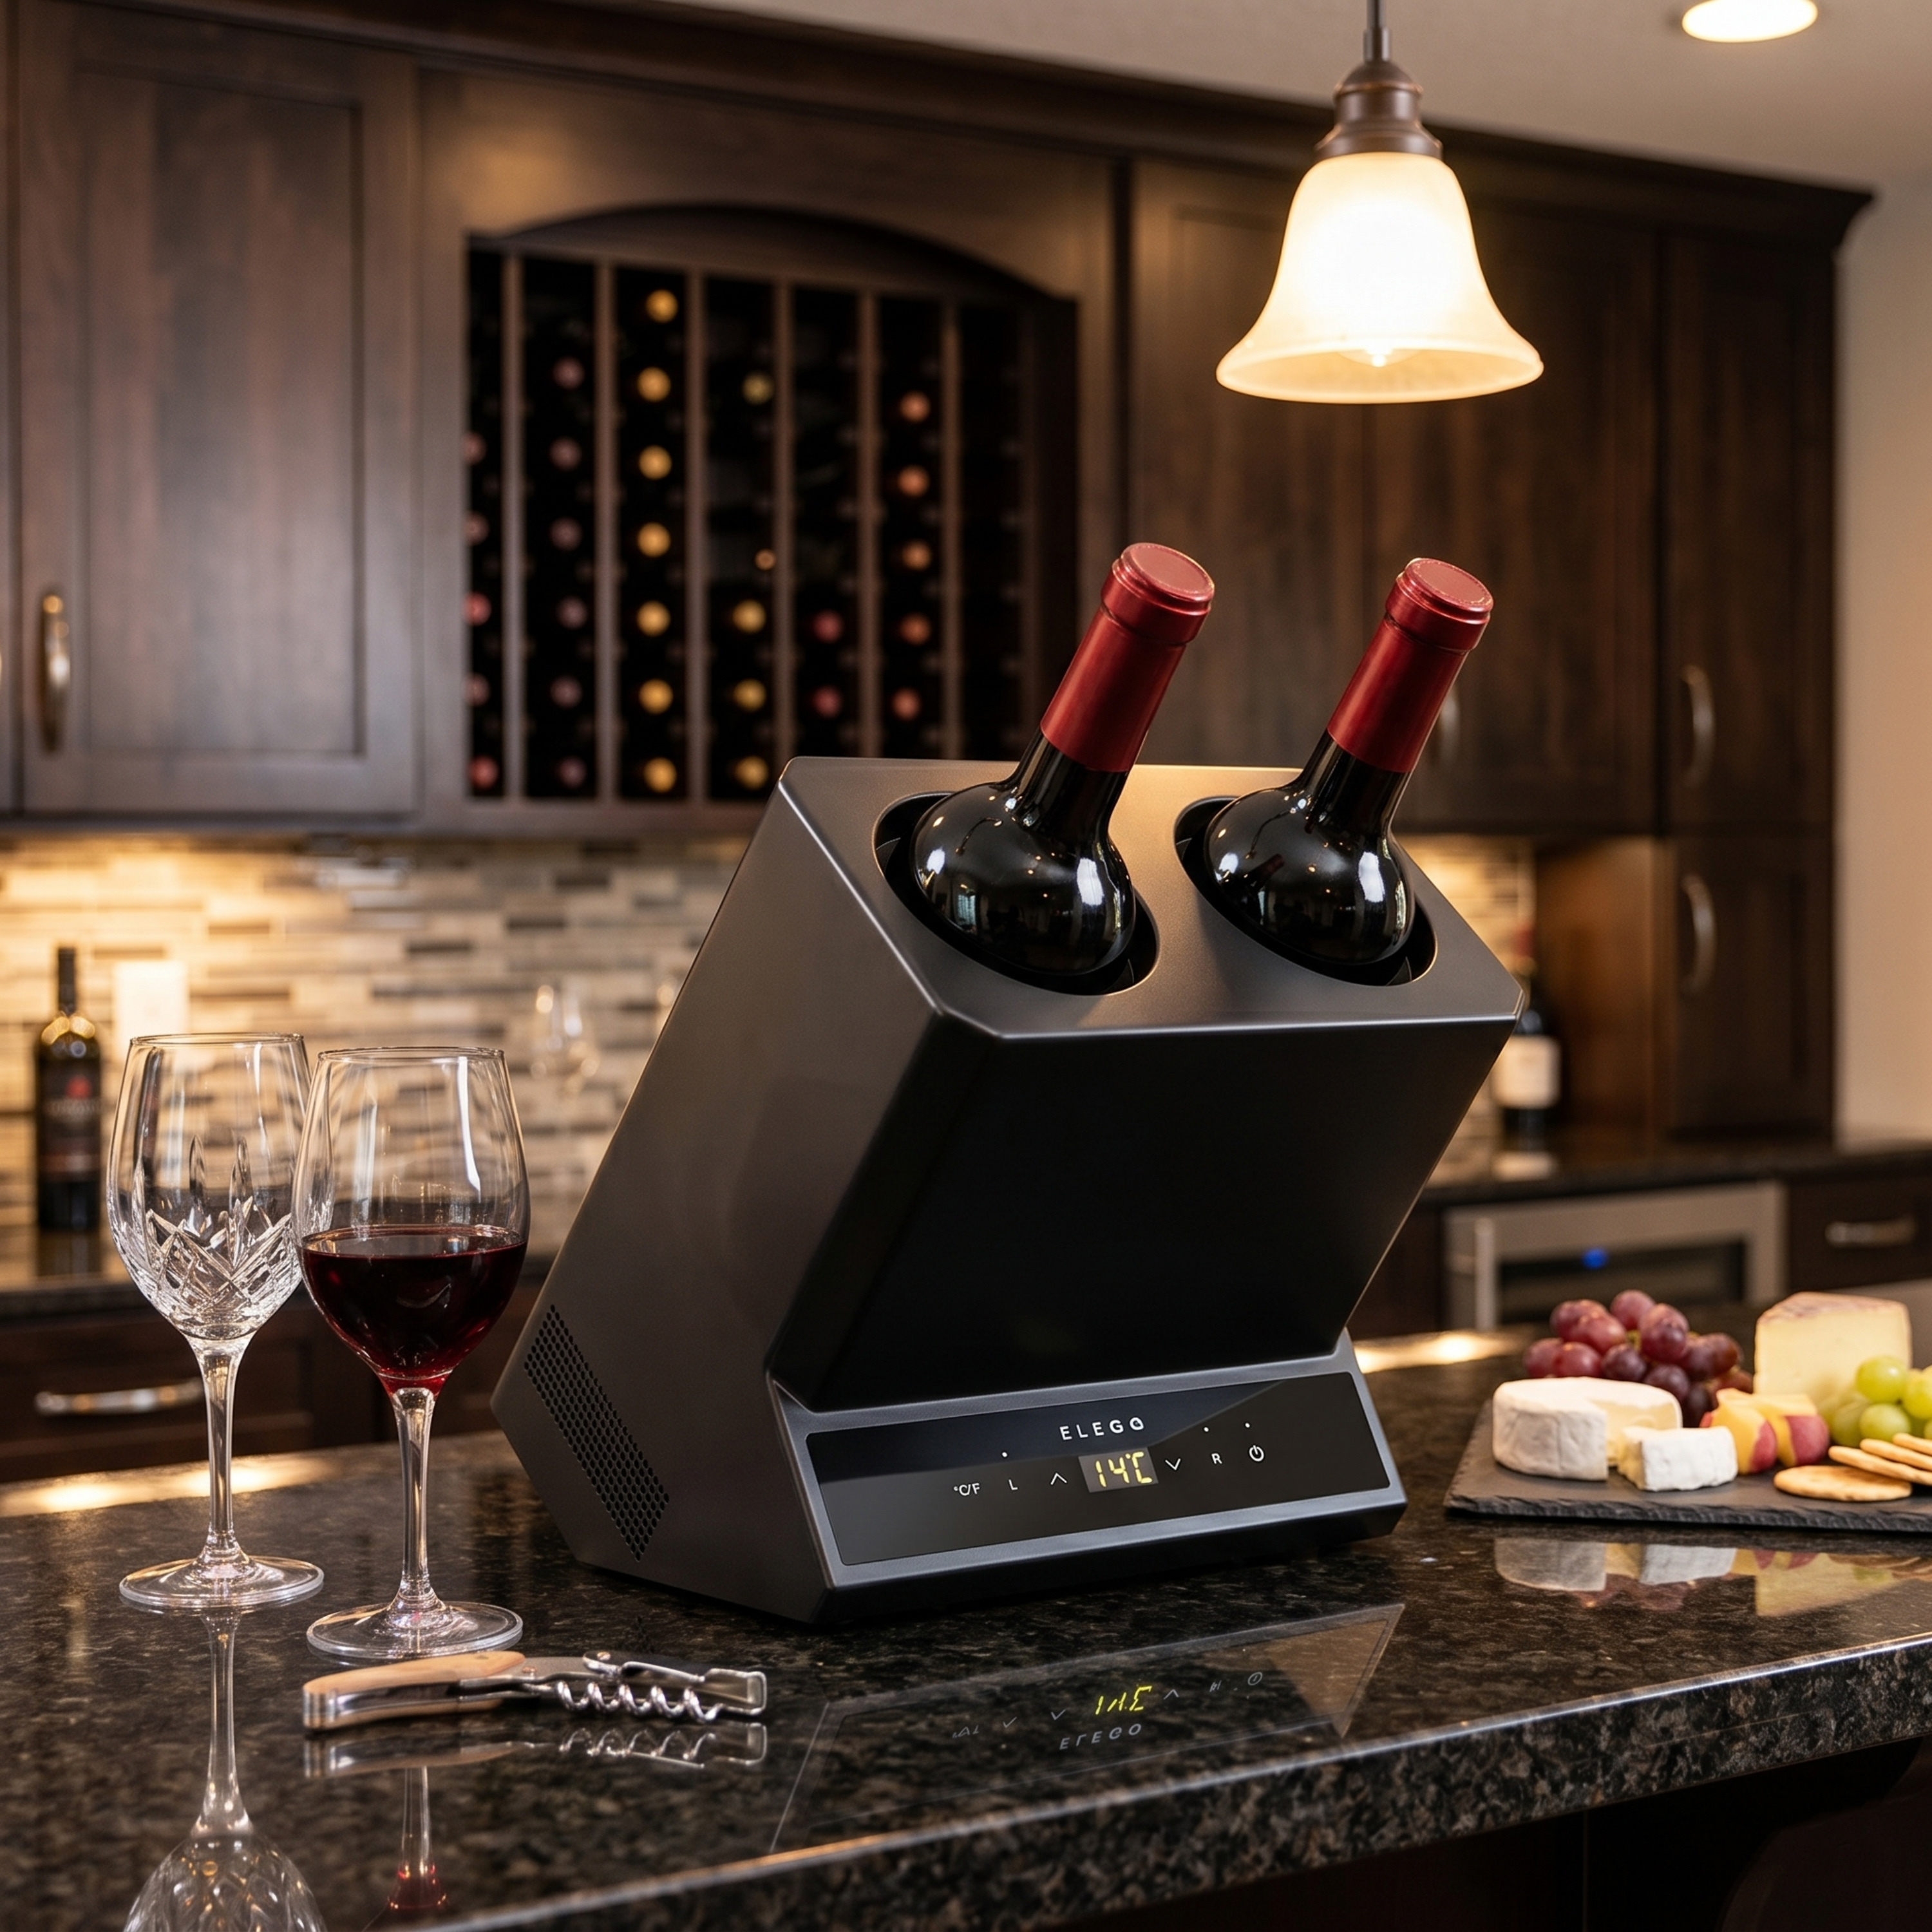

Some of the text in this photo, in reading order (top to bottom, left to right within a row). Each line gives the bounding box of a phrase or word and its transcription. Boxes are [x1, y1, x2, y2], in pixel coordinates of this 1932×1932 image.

[1059, 1416, 1144, 1441] ELEGO
[1211, 1452, 1223, 1464] R
[1008, 1479, 1019, 1491] L
